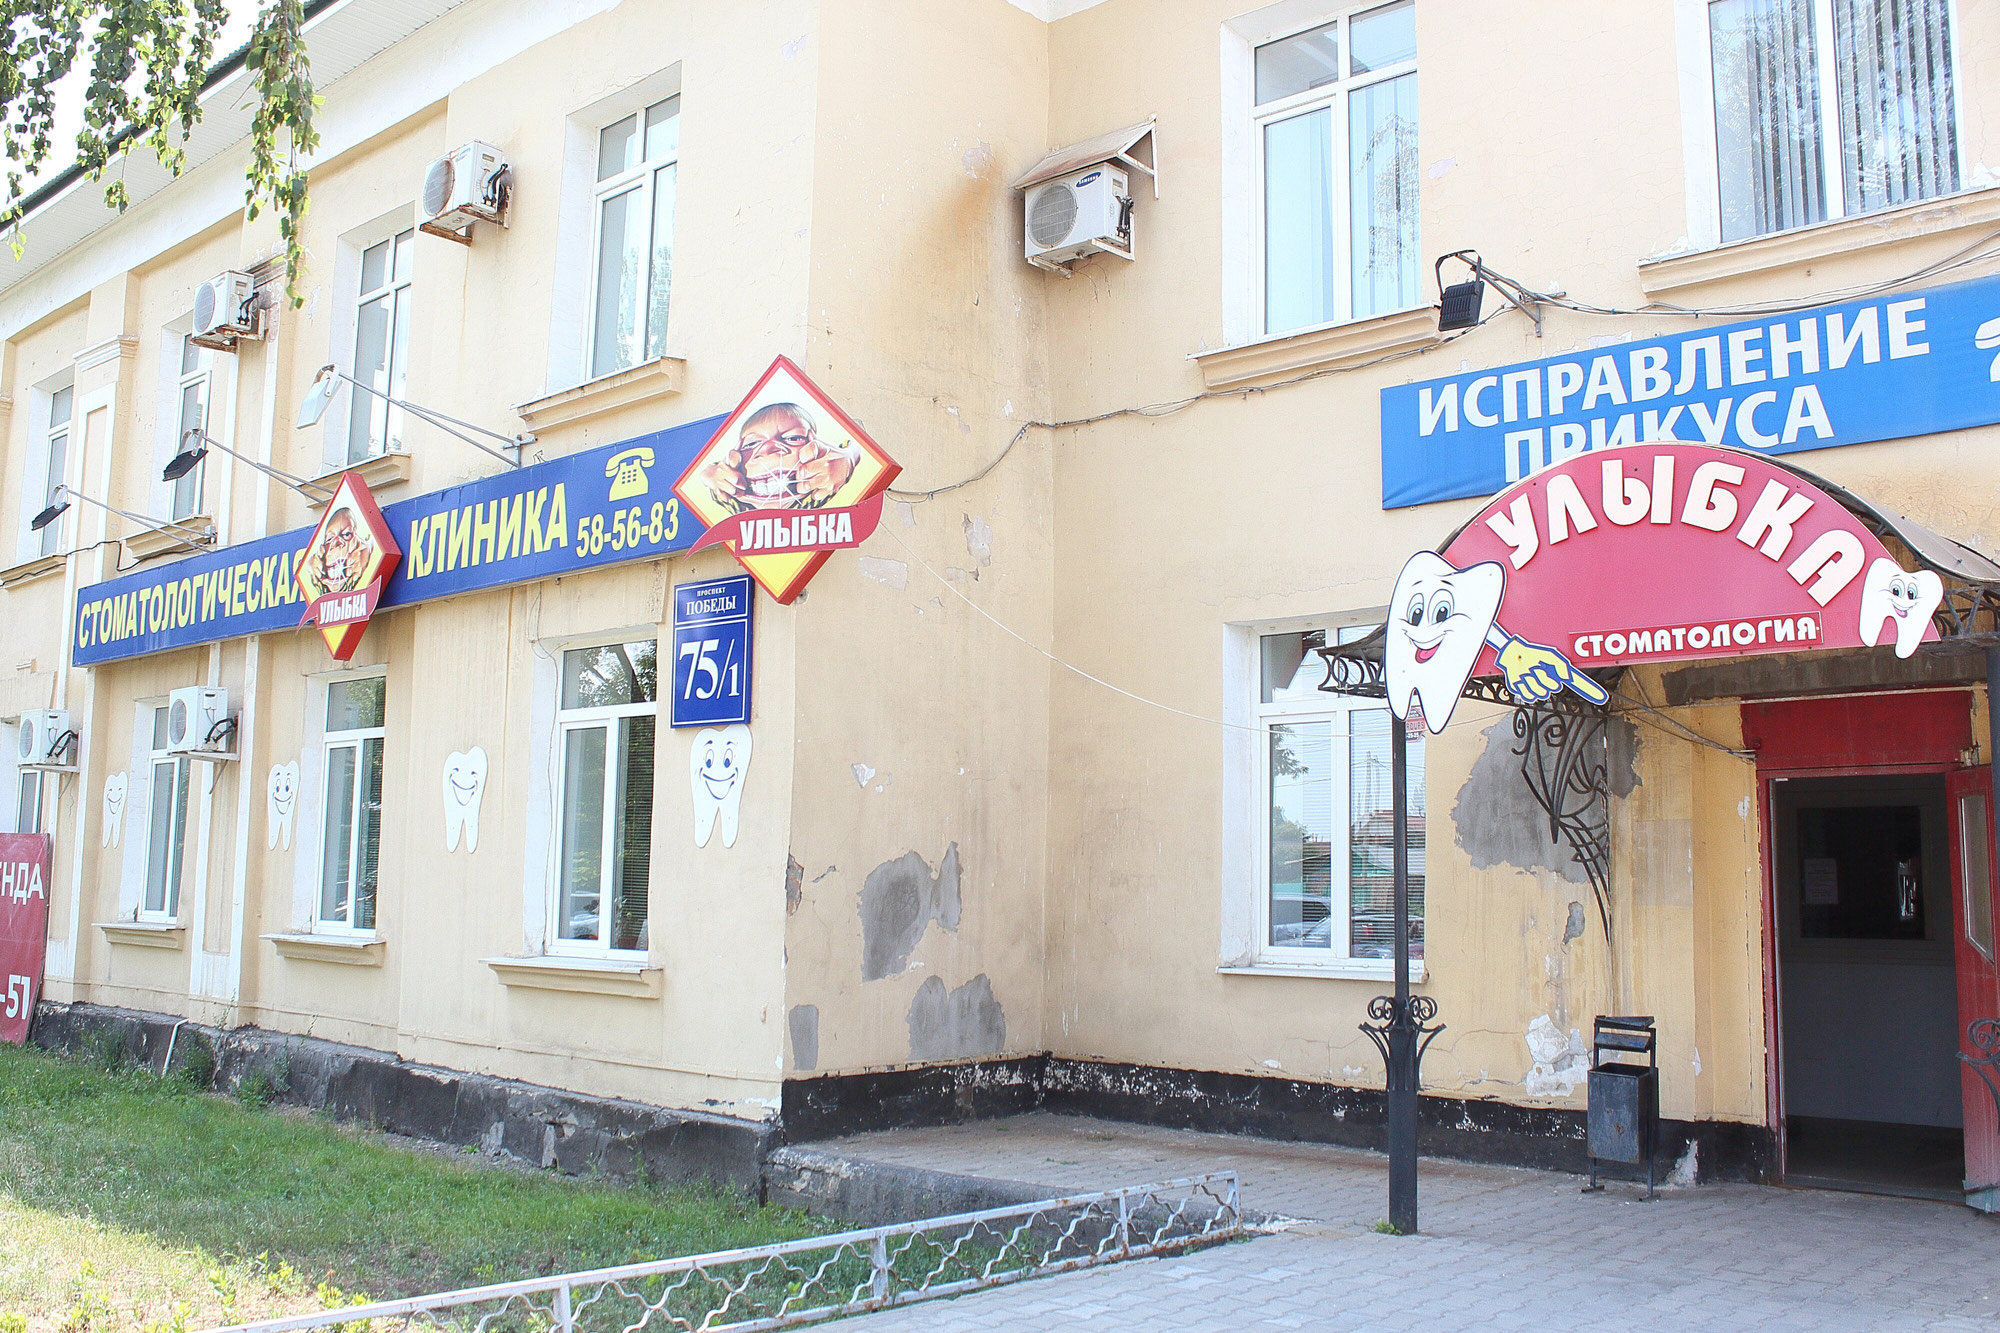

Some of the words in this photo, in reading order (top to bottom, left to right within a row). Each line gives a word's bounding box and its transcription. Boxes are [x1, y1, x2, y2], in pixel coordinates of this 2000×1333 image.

[1419, 298, 1929, 436] ИСПРАВЛЕНИЕ
[1504, 384, 1835, 483] ПРИКУСА
[408, 484, 568, 580] КЛИНИКА
[576, 499, 680, 558] 58-56-83
[739, 512, 854, 551] УЛЫБКА
[1485, 455, 1866, 608] УЛЫБКА
[320, 593, 367, 625] УЛЫБКА
[685, 595, 736, 616] ПОБЕДЫ
[697, 587, 726, 596] ПРОСПЕКТ
[1573, 617, 1818, 658] СТОМАТОЛОГИЯ
[679, 638, 739, 700] 75/1
[0, 862, 44, 905] НДА
